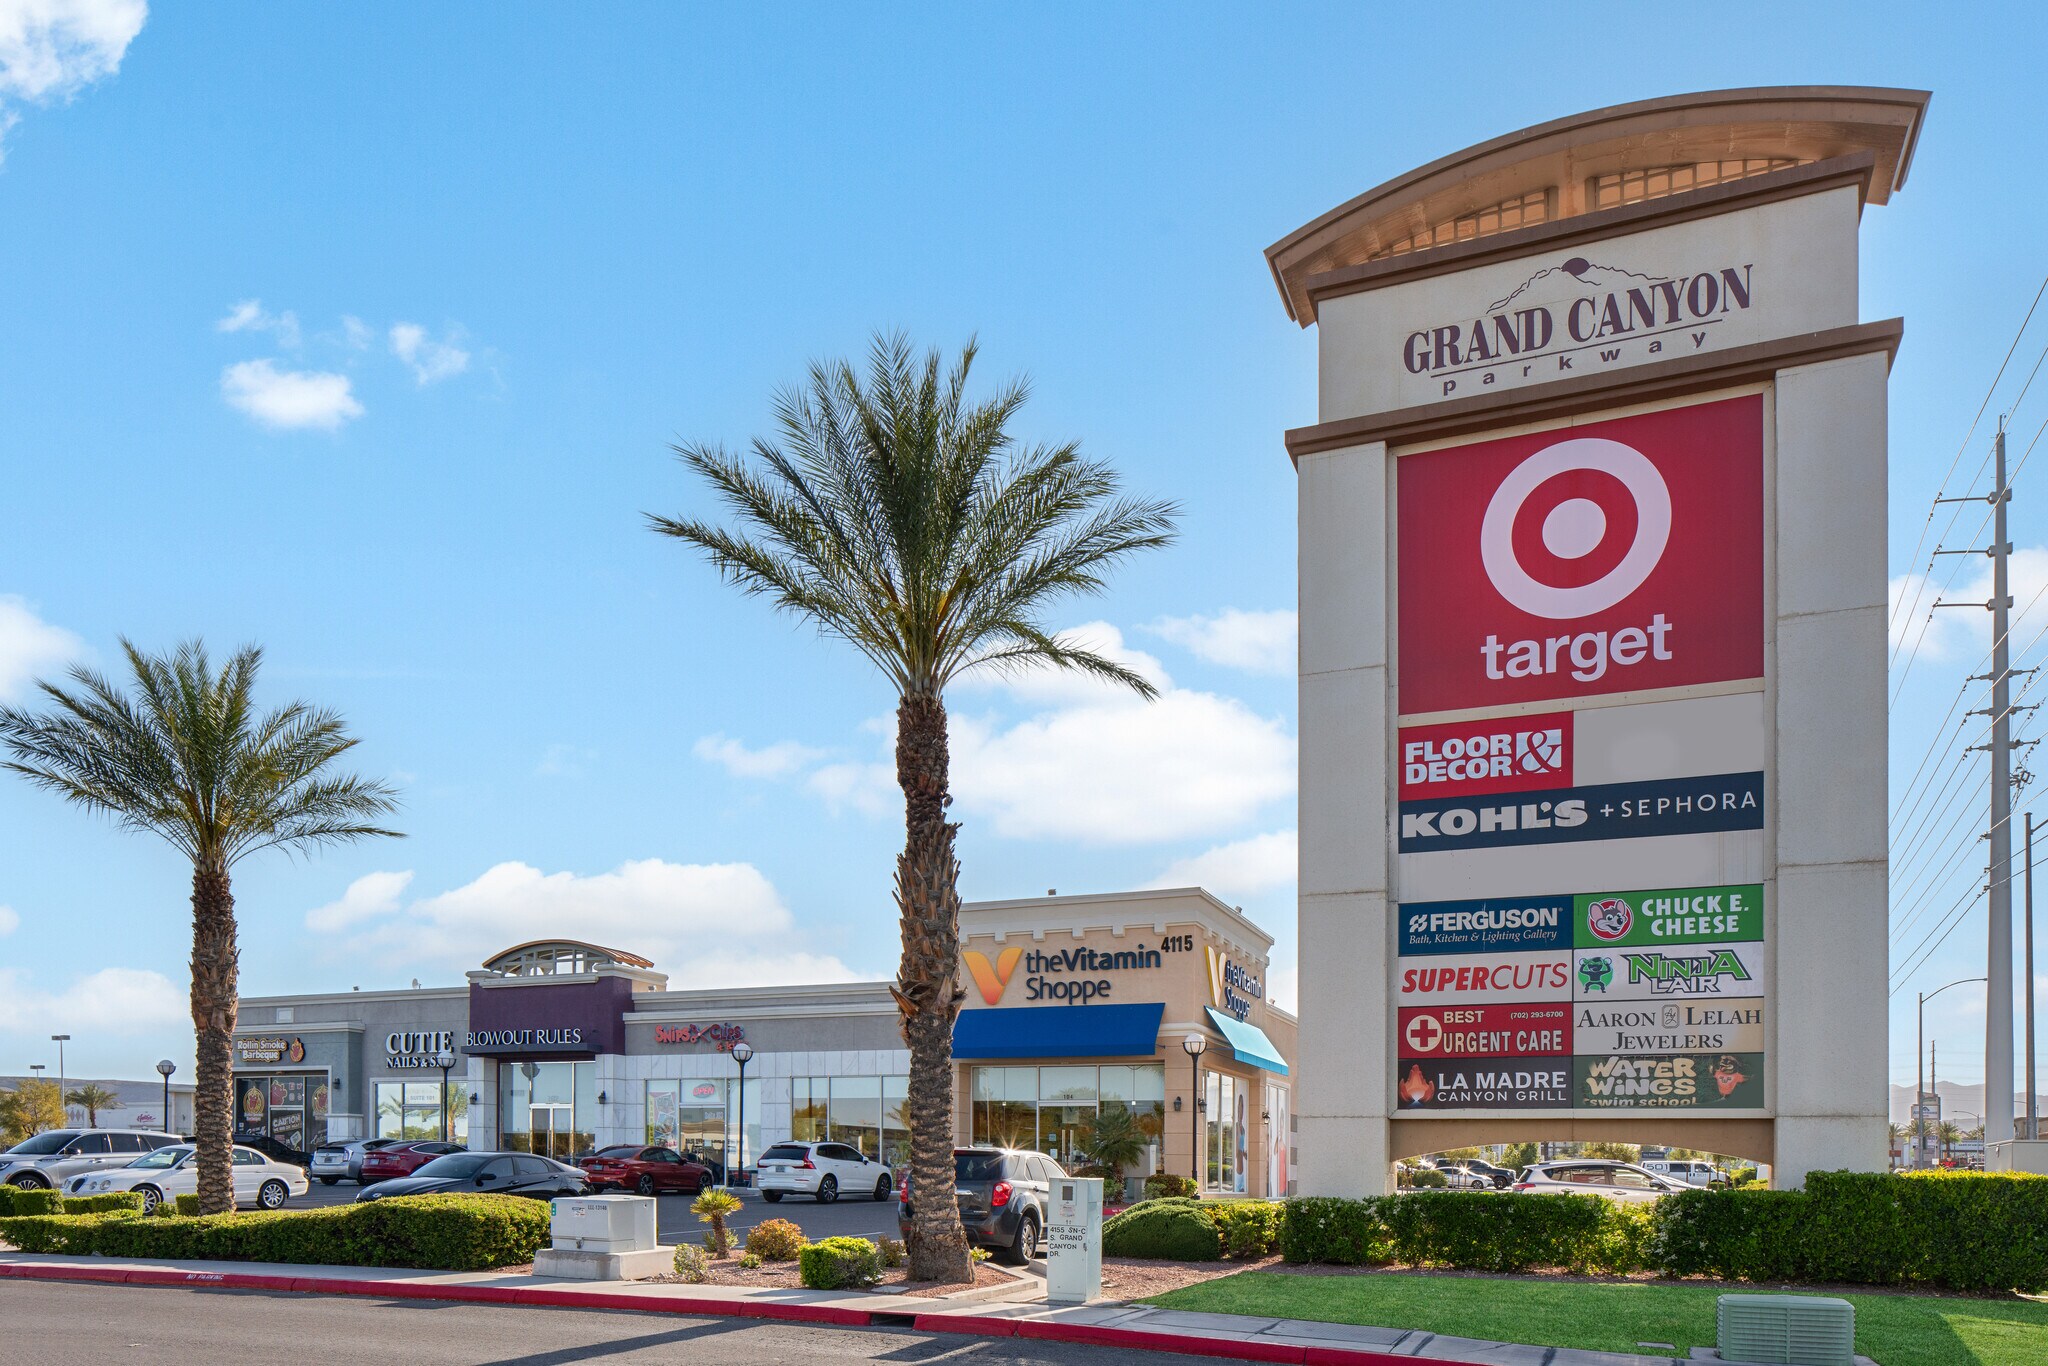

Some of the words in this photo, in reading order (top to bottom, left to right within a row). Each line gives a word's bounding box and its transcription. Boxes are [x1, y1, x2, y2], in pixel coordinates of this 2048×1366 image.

[1403, 306, 1554, 375] GRAND
[1567, 263, 1754, 343] CANYON
[1442, 330, 1707, 396] parkway
[1480, 613, 1673, 682] target
[1405, 733, 1512, 763] FLOOR
[1405, 755, 1512, 785] DECOR
[1402, 800, 1589, 838] KOHL'S
[1621, 790, 1757, 818] SEPHORA
[1641, 894, 1723, 917] CHUCK
[1729, 894, 1750, 912] E.
[1430, 907, 1558, 932] FERGUSON
[1650, 914, 1740, 937] CHEESE
[1160, 934, 1194, 953] 4115
[1409, 935, 1432, 945] Bath,
[1434, 932, 1468, 943] Kitchen
[1470, 933, 1480, 941] &
[1482, 931, 1521, 944] Lighting
[1523, 929, 1558, 941] Gallery
[1025, 943, 1162, 974] theVitamin
[1620, 949, 1752, 985] NINJA
[1401, 962, 1568, 994] SUPERCUTS
[1650, 975, 1722, 994] LAIR
[1025, 976, 1112, 1005] Shoppe
[1443, 1010, 1485, 1024] BEST
[1510, 1012, 1529, 1020] (702)
[1576, 1009, 1656, 1028] AARON
[1685, 1006, 1762, 1026] LELAH
[237, 1040, 259, 1050] Rollin
[260, 1040, 286, 1050] Smoke
[385, 1030, 453, 1055] CUTIE
[466, 1029, 533, 1047] BLOWOUT
[536, 1028, 583, 1045] RULES
[1443, 1031, 1512, 1054] URGENT
[1516, 1030, 1563, 1052] CARE
[1612, 1031, 1724, 1051] JEWELERS
[242, 1049, 279, 1061] Barbeque
[385, 1056, 420, 1069] NAILS
[420, 1058, 429, 1068] &
[1588, 1055, 1698, 1079] WATER
[692, 1085, 716, 1097] OPEN
[1438, 1072, 1469, 1090] LA
[1475, 1071, 1567, 1090] MADRE
[1437, 1091, 1508, 1102] CANYON
[1515, 1090, 1567, 1101] GRILL
[1589, 1097, 1634, 1107] swim
[1638, 1096, 1697, 1107] school
[1646, 1163, 1668, 1171] 501
[1059, 1233, 1083, 1242] GRAND
